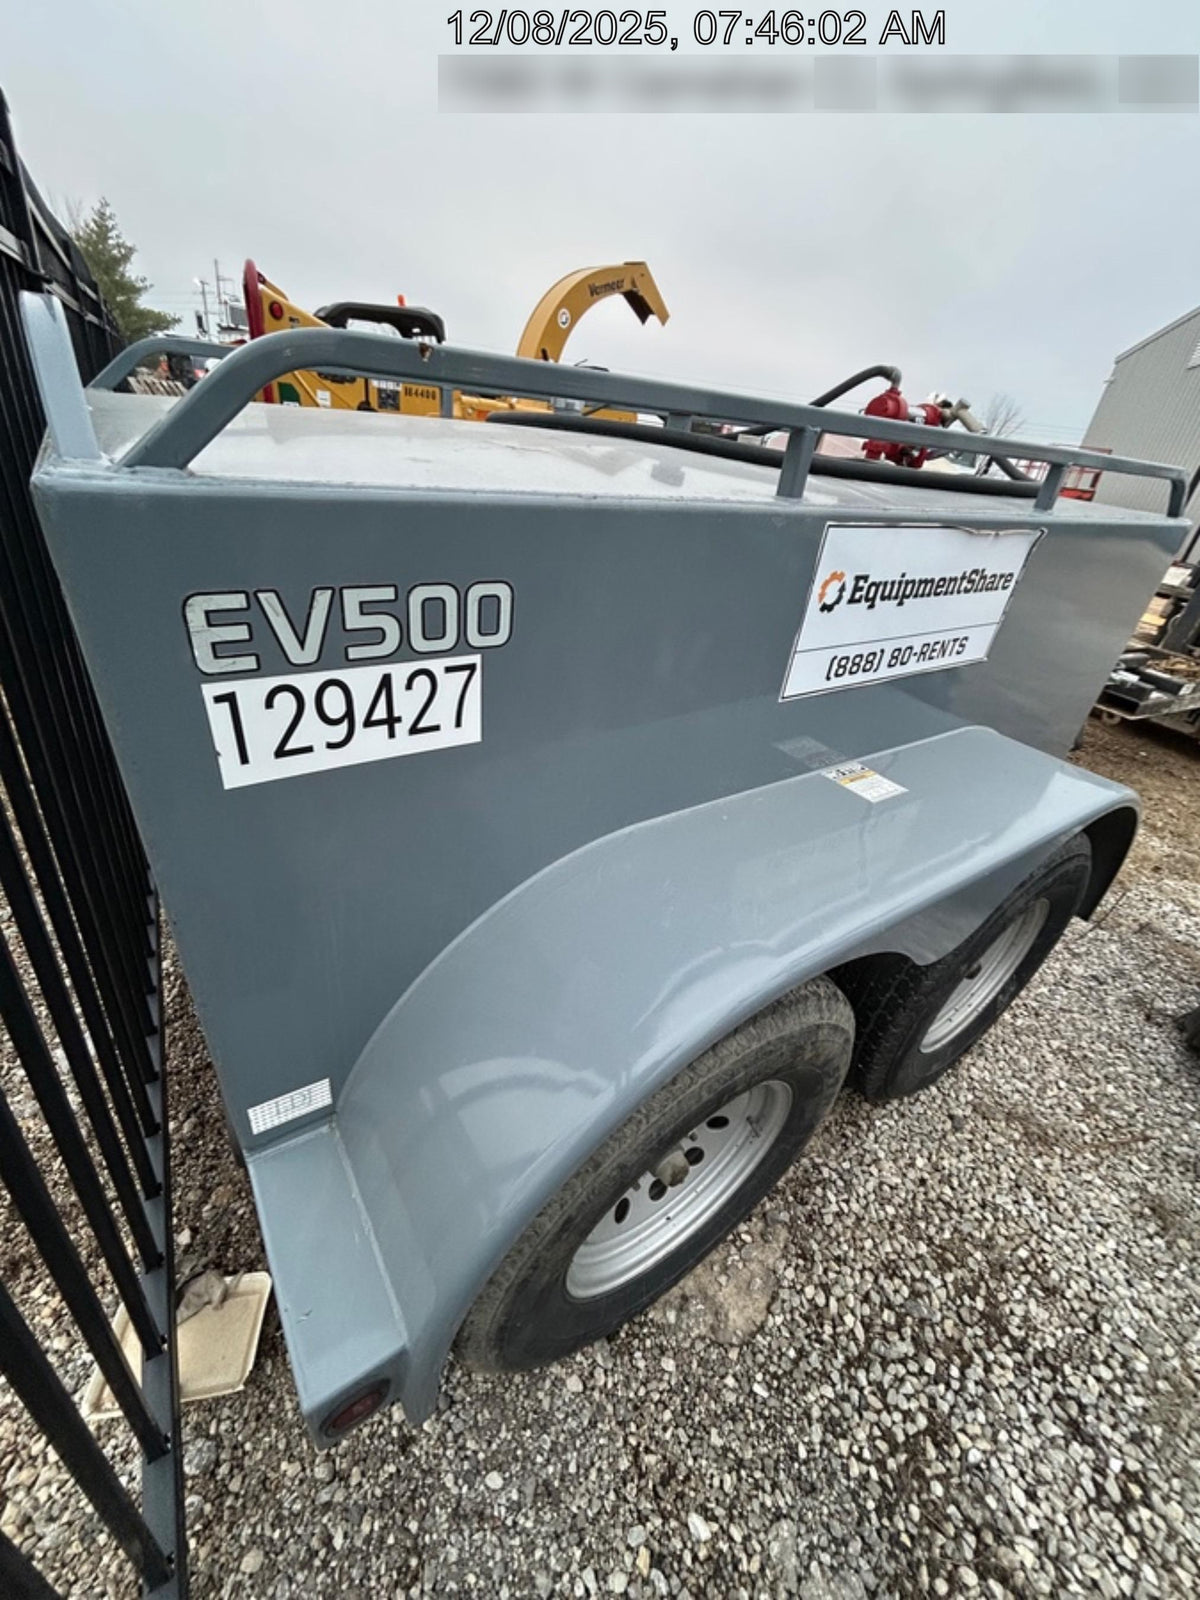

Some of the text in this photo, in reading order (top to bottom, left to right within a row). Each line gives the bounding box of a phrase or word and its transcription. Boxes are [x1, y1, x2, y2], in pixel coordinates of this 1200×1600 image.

[847, 568, 1015, 610] EquipmentShare
[182, 580, 515, 675] EV500
[825, 635, 970, 682] (888) 80-RENTS
[212, 662, 478, 766] 129427
